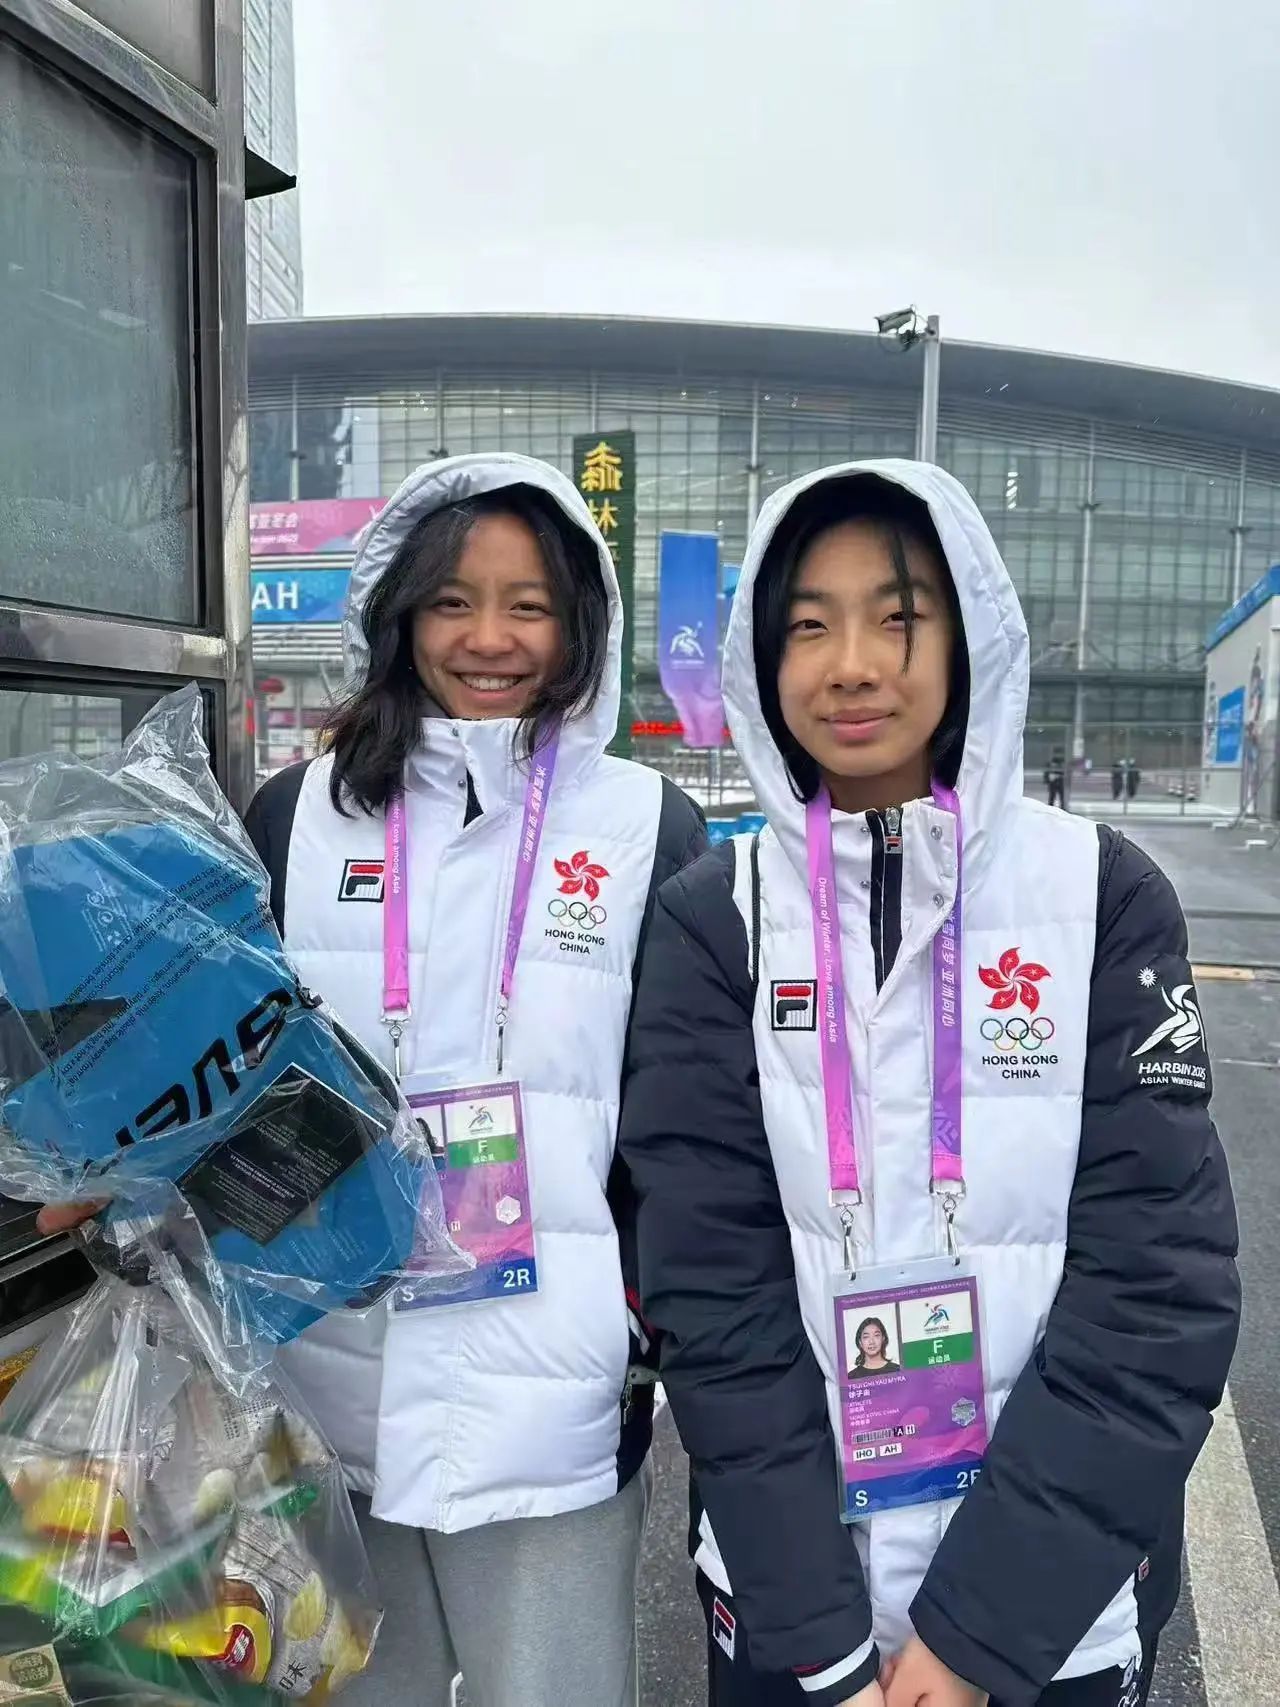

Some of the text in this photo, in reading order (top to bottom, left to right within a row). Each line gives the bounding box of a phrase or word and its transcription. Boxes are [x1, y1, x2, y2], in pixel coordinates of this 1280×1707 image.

[251, 581, 299, 611] AH
[544, 928, 605, 946] HONG KONG
[558, 942, 591, 955] CHINA
[982, 1054, 1059, 1066] HONG KONG
[1001, 1069, 1041, 1079] CHINA
[1138, 1061, 1191, 1076] HARBIN
[1140, 1076, 1169, 1085] ASIAN
[478, 1140, 487, 1153] F
[503, 1268, 530, 1288] 2R
[933, 1340, 943, 1353] F
[856, 1445, 898, 1459] IHO AH
[855, 1490, 868, 1507] S
